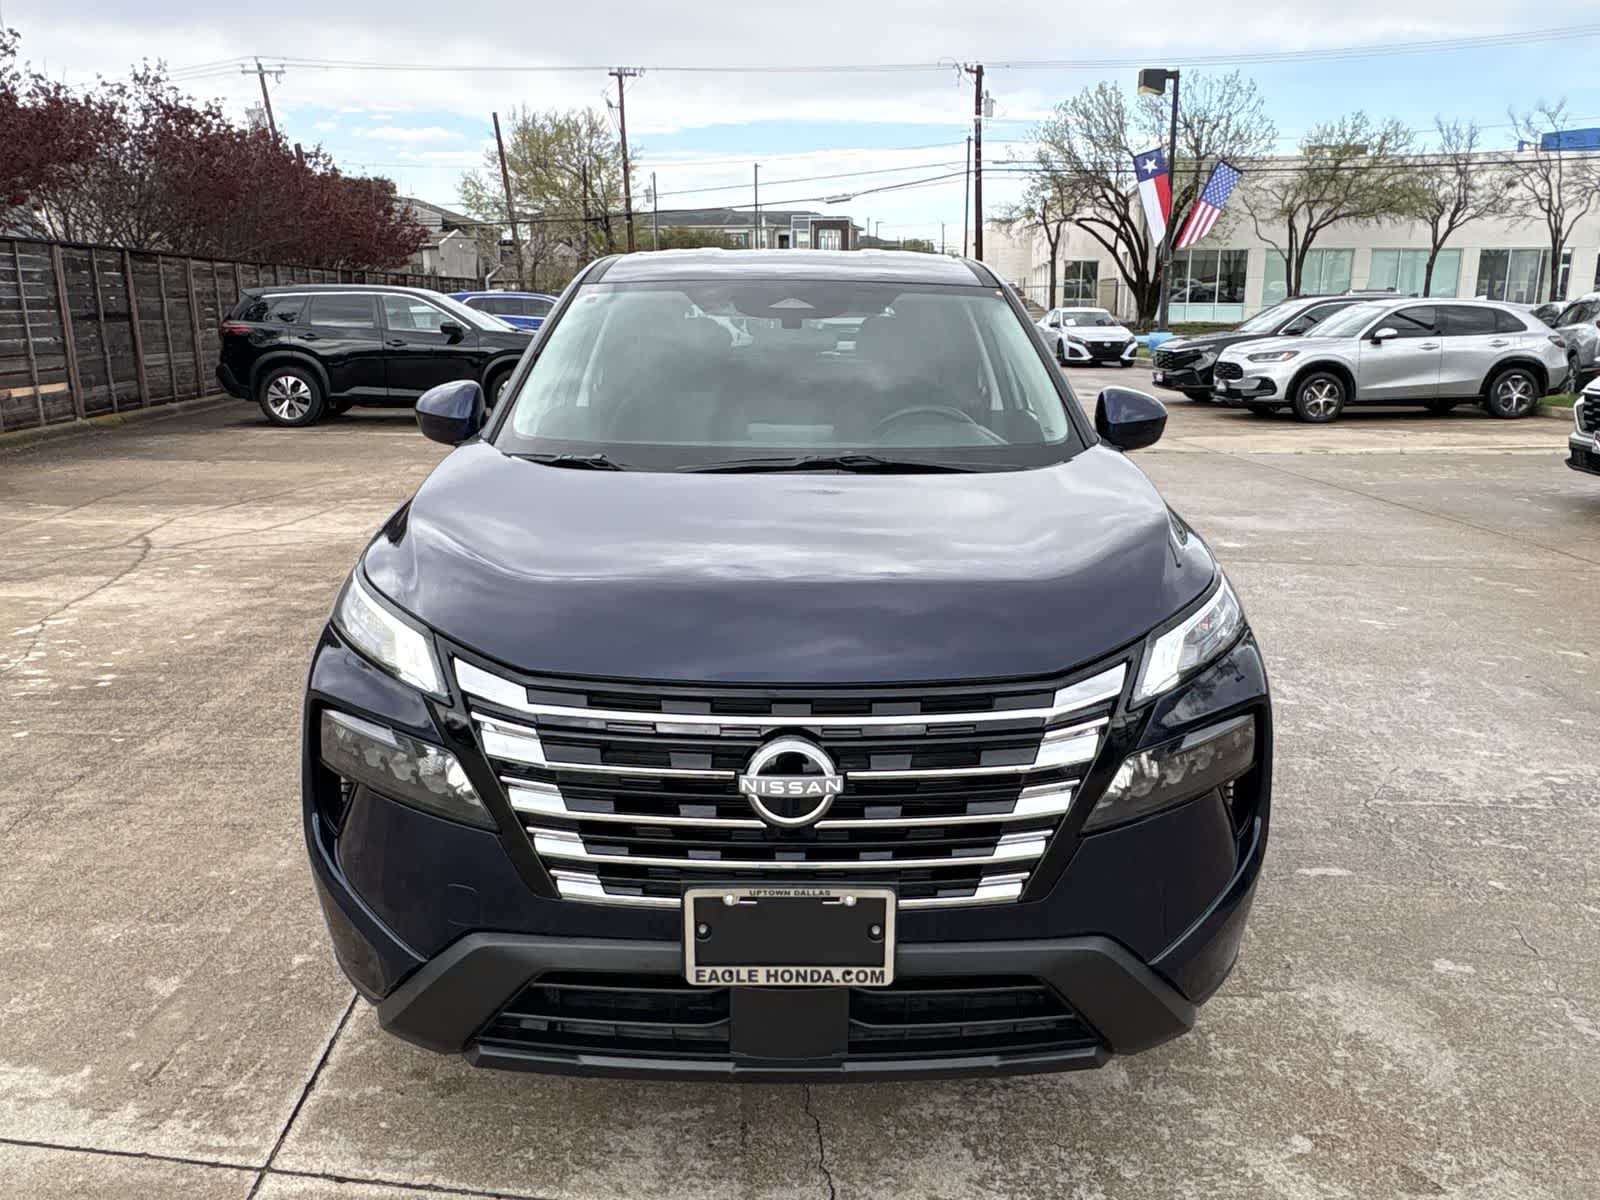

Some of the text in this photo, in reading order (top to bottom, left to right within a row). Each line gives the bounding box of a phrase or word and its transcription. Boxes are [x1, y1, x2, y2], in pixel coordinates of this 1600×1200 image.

[741, 779, 841, 794] NISSAN
[695, 969, 885, 983] EAGLE HONDA.COM
